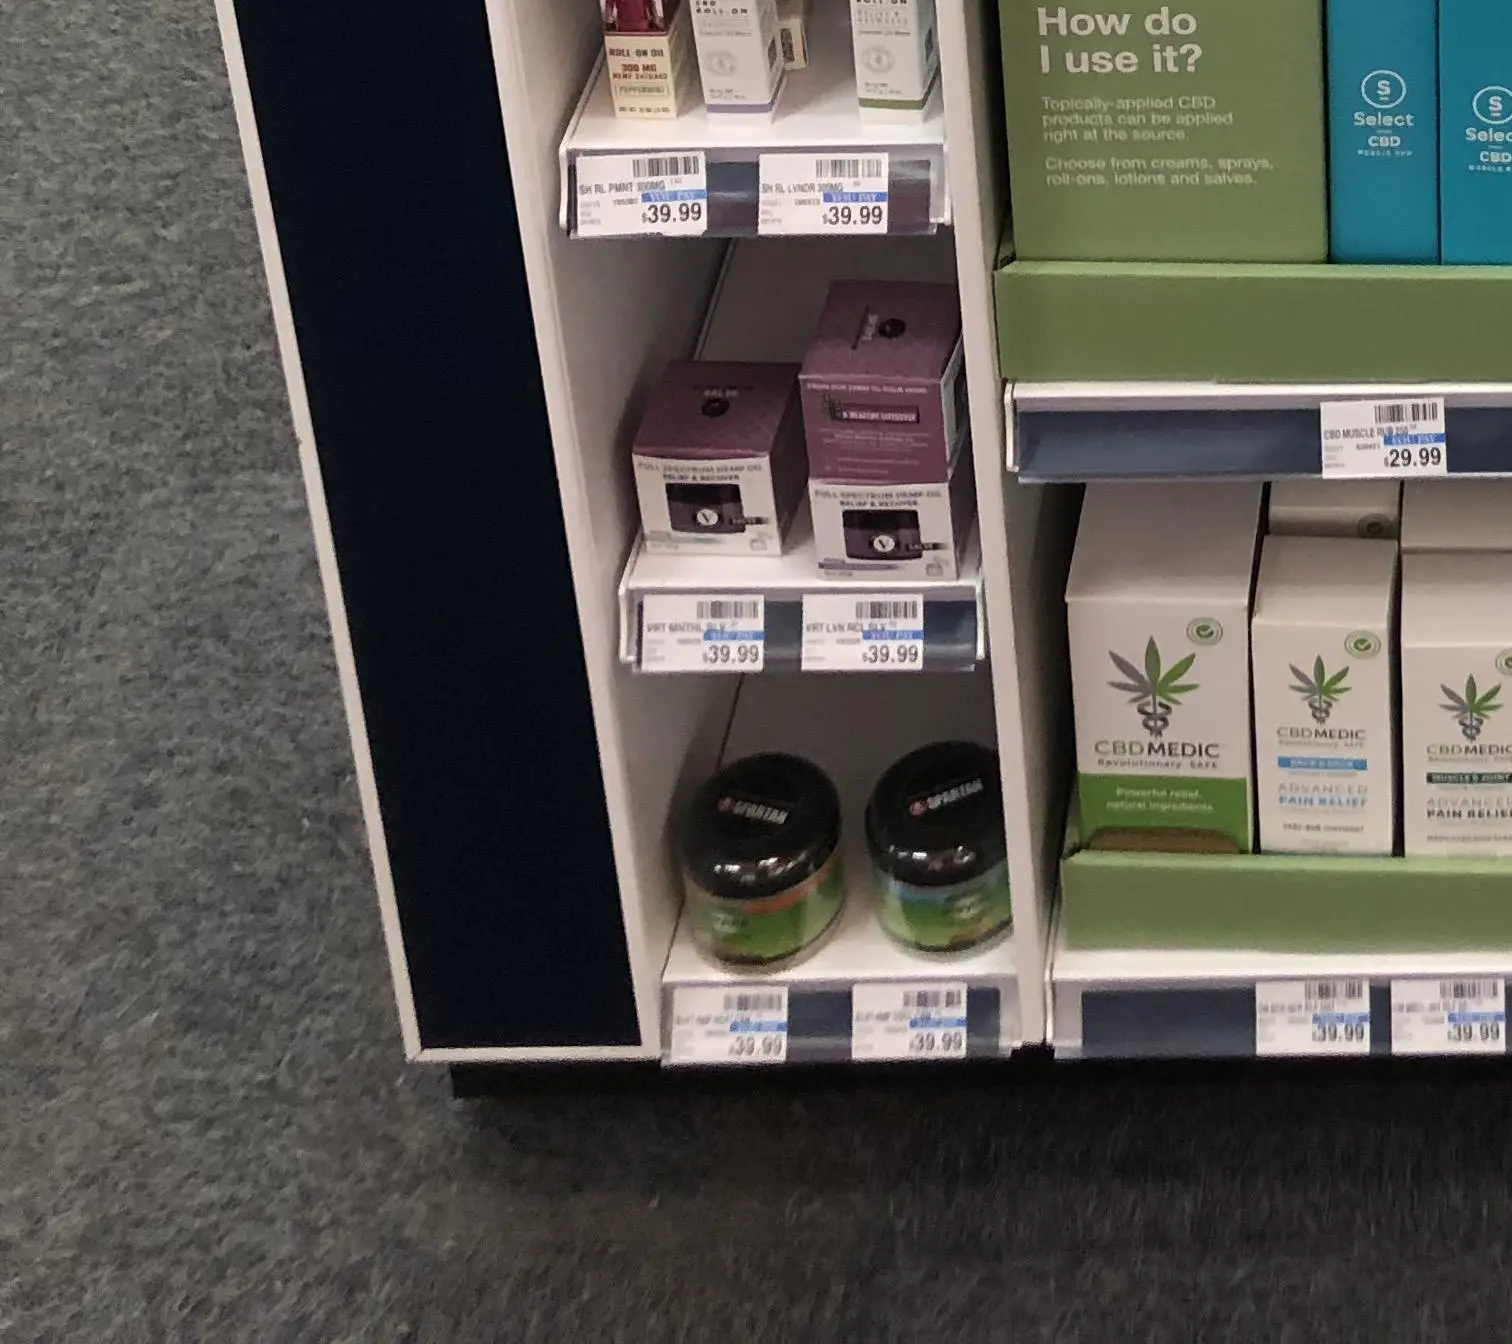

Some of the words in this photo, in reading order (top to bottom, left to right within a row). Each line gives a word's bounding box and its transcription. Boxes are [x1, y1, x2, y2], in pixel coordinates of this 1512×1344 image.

[1037, 7, 1131, 35] How
[1144, 6, 1197, 35] do
[1040, 45, 1050, 74] I
[1065, 51, 1139, 73] use
[1153, 44, 1202, 73] it?
[1178, 96, 1216, 109] CBD
[1042, 113, 1113, 128] products
[1118, 114, 1146, 125] can
[1151, 113, 1171, 124] be
[1176, 112, 1233, 127] applied
[1354, 112, 1415, 128] Select
[1044, 129, 1078, 144] right
[1083, 129, 1097, 141] at
[1104, 128, 1127, 141] the
[1368, 135, 1401, 147] CBD
[1479, 151, 1512, 163] CBD
[642, 203, 702, 223] $39.99
[822, 206, 883, 225] $39.99
[1384, 447, 1441, 468] $29.99
[702, 645, 759, 663] $39.99
[862, 644, 918, 662] $39.99
[1277, 726, 1365, 739] CBDMEDIC
[1094, 740, 1220, 759] CBDMEDIC
[1427, 809, 1462, 818] PAIN
